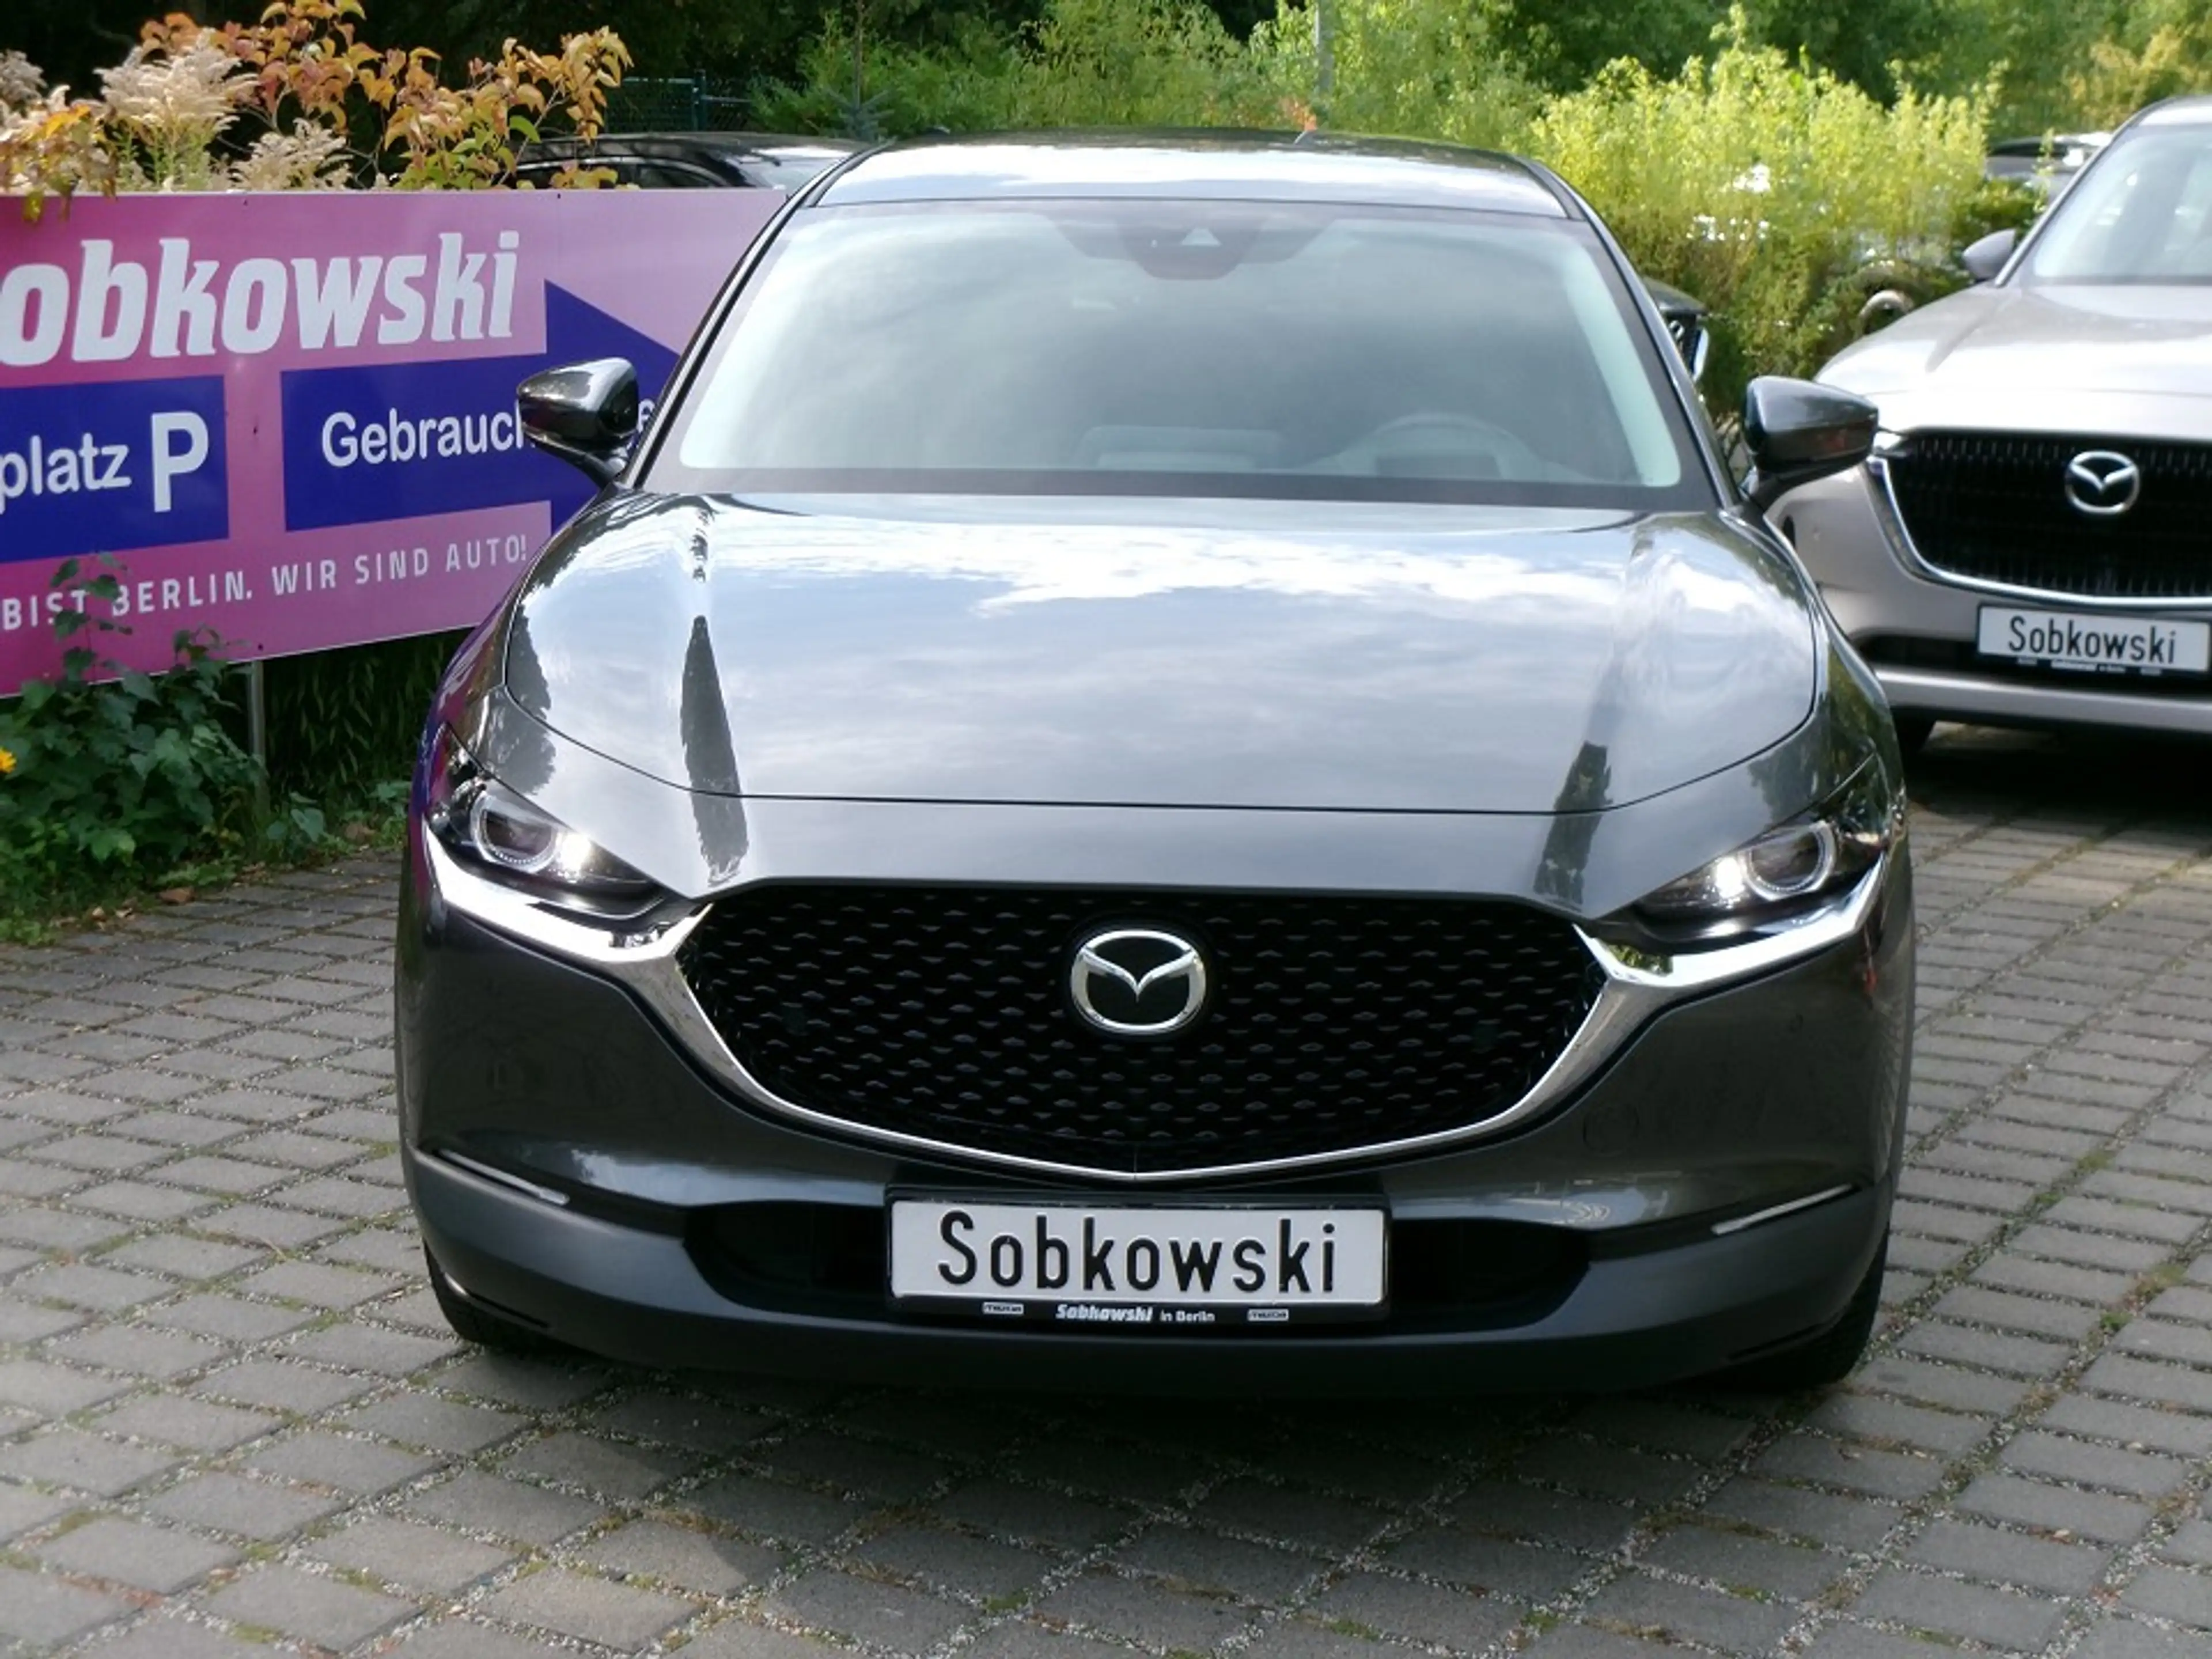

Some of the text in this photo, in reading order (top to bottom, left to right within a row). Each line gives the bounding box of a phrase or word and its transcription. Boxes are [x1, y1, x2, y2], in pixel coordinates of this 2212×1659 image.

[0, 411, 209, 514] platz P
[2, 535, 527, 630] BIST BERLIN. WIR SIND AUTO!
[2008, 615, 2176, 664] Sobkowski
[937, 1210, 1336, 1293] Sobkowski
[1055, 1304, 1153, 1321] Sobkowski
